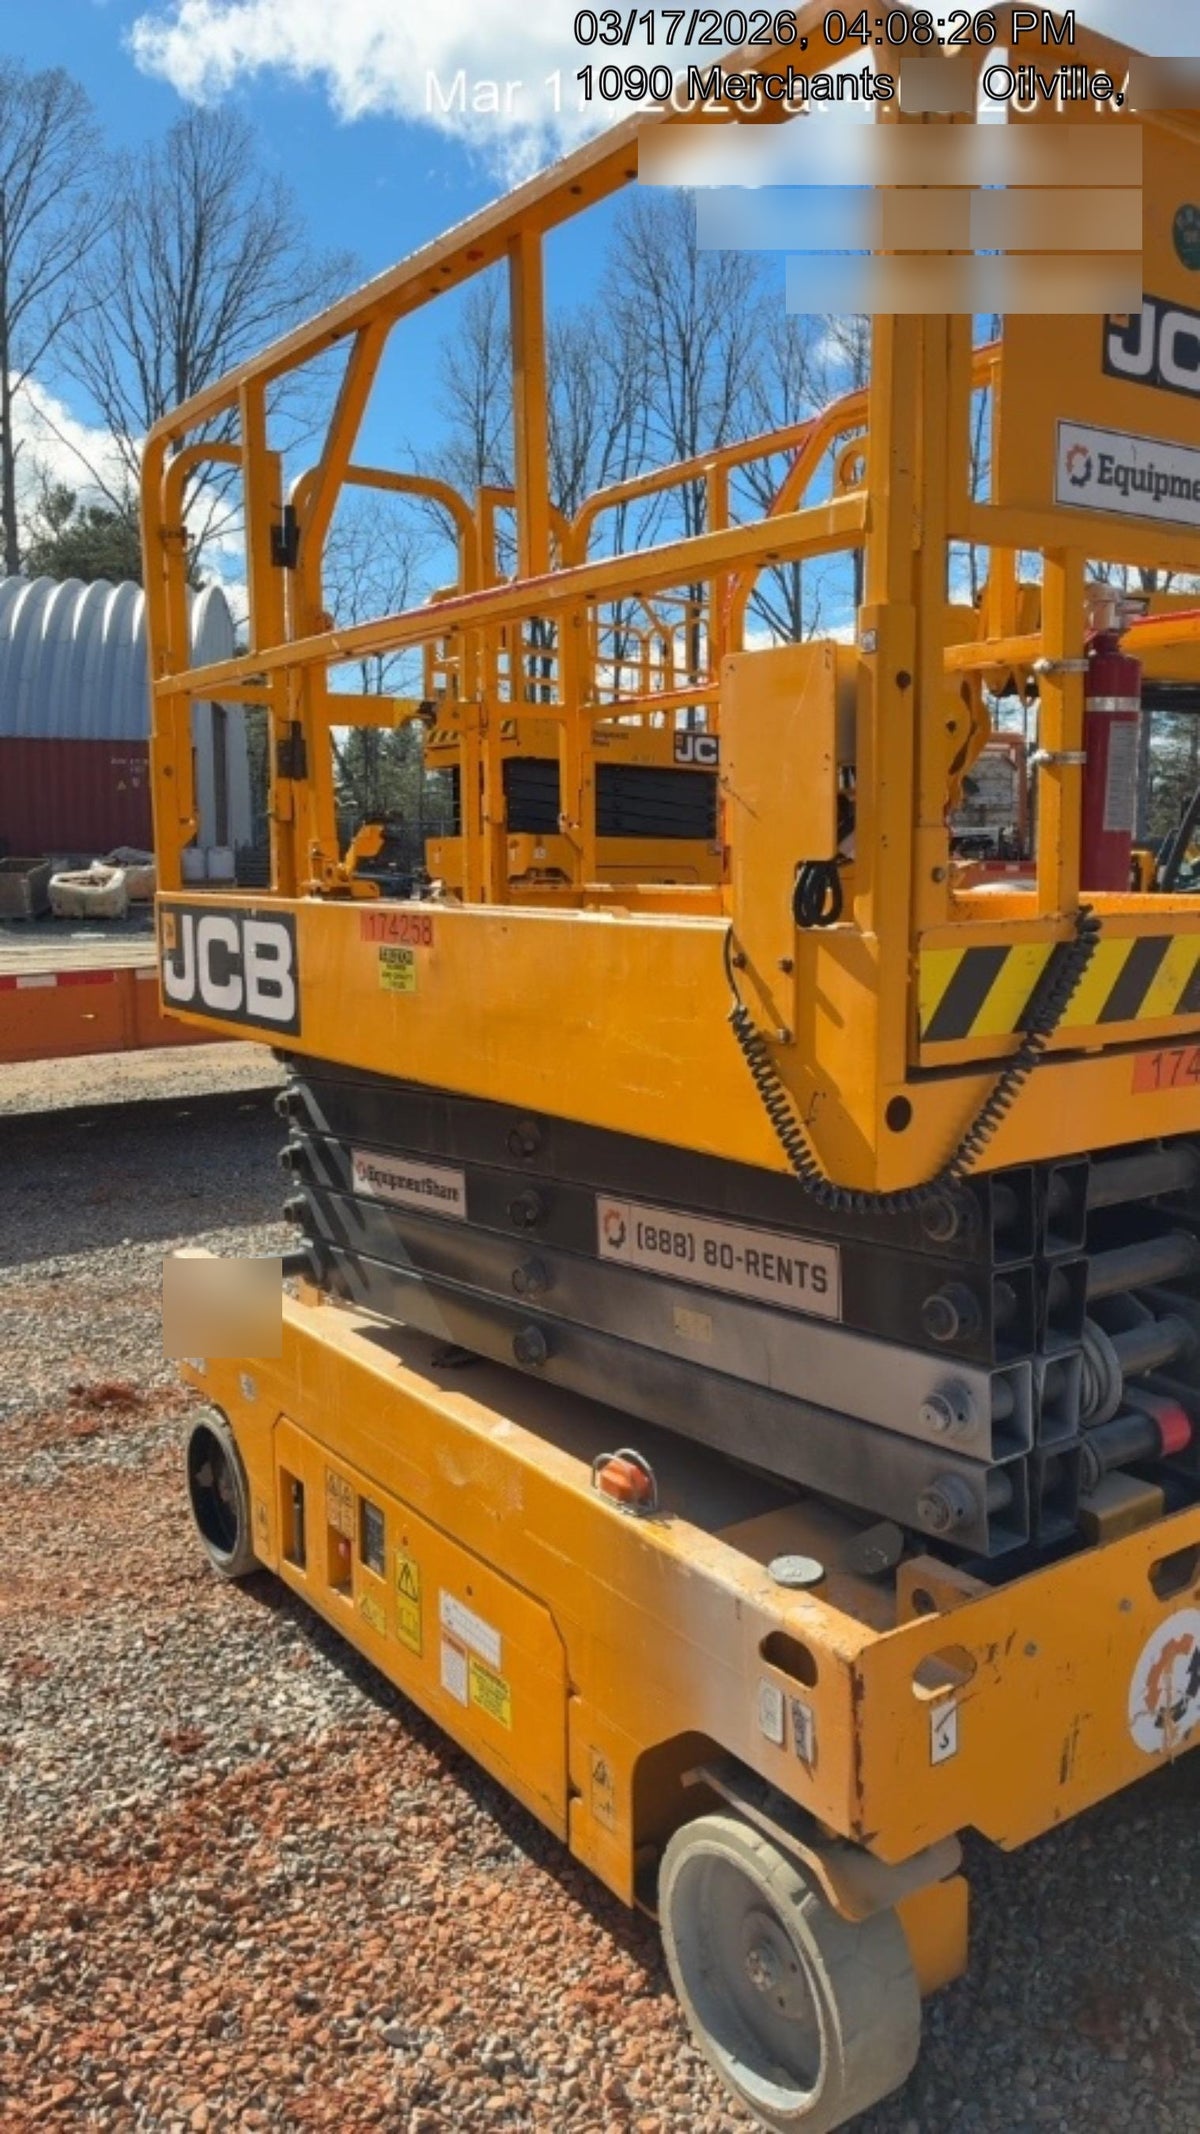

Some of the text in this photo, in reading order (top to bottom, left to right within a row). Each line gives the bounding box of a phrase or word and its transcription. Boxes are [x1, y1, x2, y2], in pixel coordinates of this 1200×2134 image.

[369, 912, 432, 946] 174258
[163, 914, 296, 1022] JCB
[637, 1221, 829, 1294] (888) 80-RENTS
